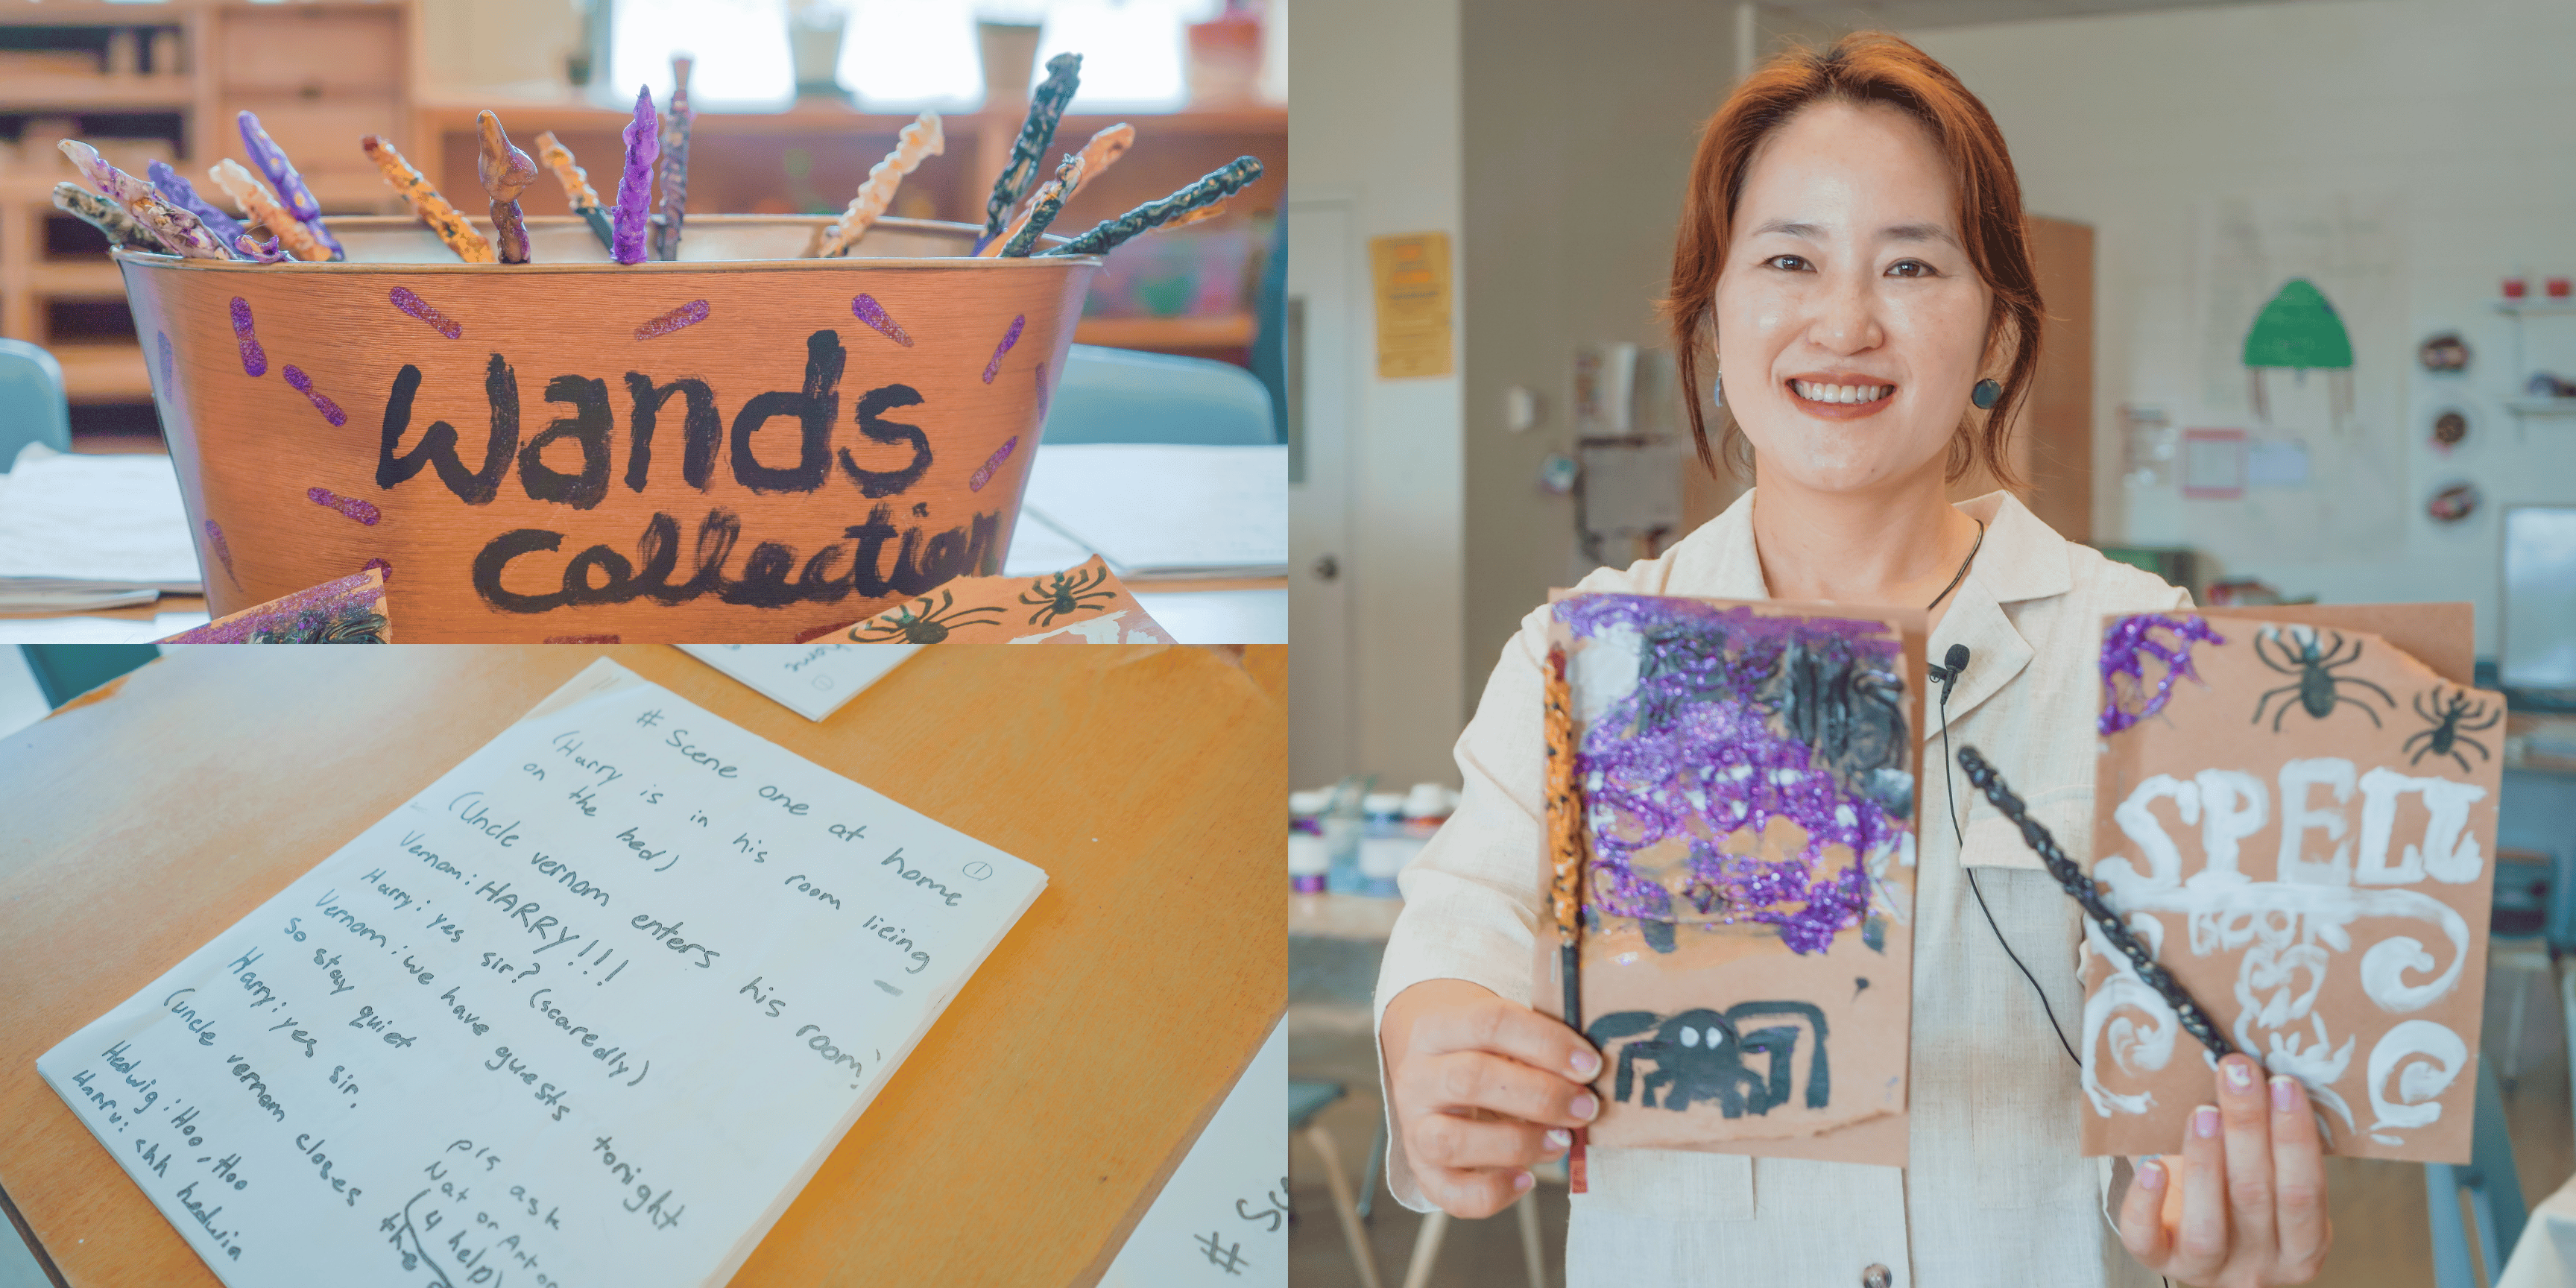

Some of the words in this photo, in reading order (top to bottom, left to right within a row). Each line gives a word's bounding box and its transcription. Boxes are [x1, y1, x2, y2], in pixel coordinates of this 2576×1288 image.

[376, 329, 933, 511] Wands
[523, 763, 546, 781] on
[569, 785, 597, 817] the
[616, 827, 680, 873] bed)
[552, 730, 623, 787] (Harry
[640, 783, 663, 804] is
[690, 809, 708, 827] in
[733, 832, 768, 863] his
[784, 874, 841, 910] room
[637, 709, 665, 728] #
[666, 729, 738, 778] Scene
[759, 785, 809, 815] one
[828, 824, 867, 842] at
[881, 847, 962, 906] home
[2093, 756, 2488, 891] SPELL
[449, 790, 521, 847] (Uncle
[531, 851, 610, 908] vernom
[631, 914, 721, 969] enters
[739, 976, 786, 1017] his
[475, 880, 628, 986] HARRY!!!
[313, 947, 355, 996] stay
[348, 1005, 417, 1049] quiet
[426, 913, 464, 943] yes
[481, 951, 540, 985] sir?
[528, 988, 649, 1087] (scaredly)
[163, 988, 216, 1046] (uncle
[227, 1053, 285, 1123] vernom
[296, 1133, 362, 1207] closes
[268, 1017, 318, 1058] yes
[329, 1064, 359, 1109] sir.
[403, 955, 435, 985] we
[441, 985, 490, 1036] have
[484, 1046, 570, 1122] guests
[593, 1135, 685, 1231] tonight
[379, 1211, 418, 1272] the
[423, 1161, 470, 1202] Nat
[446, 1139, 501, 1172] pls
[509, 1185, 560, 1231] ask
[1193, 1231, 1249, 1276] #
[1236, 1175, 1288, 1232] Sc
